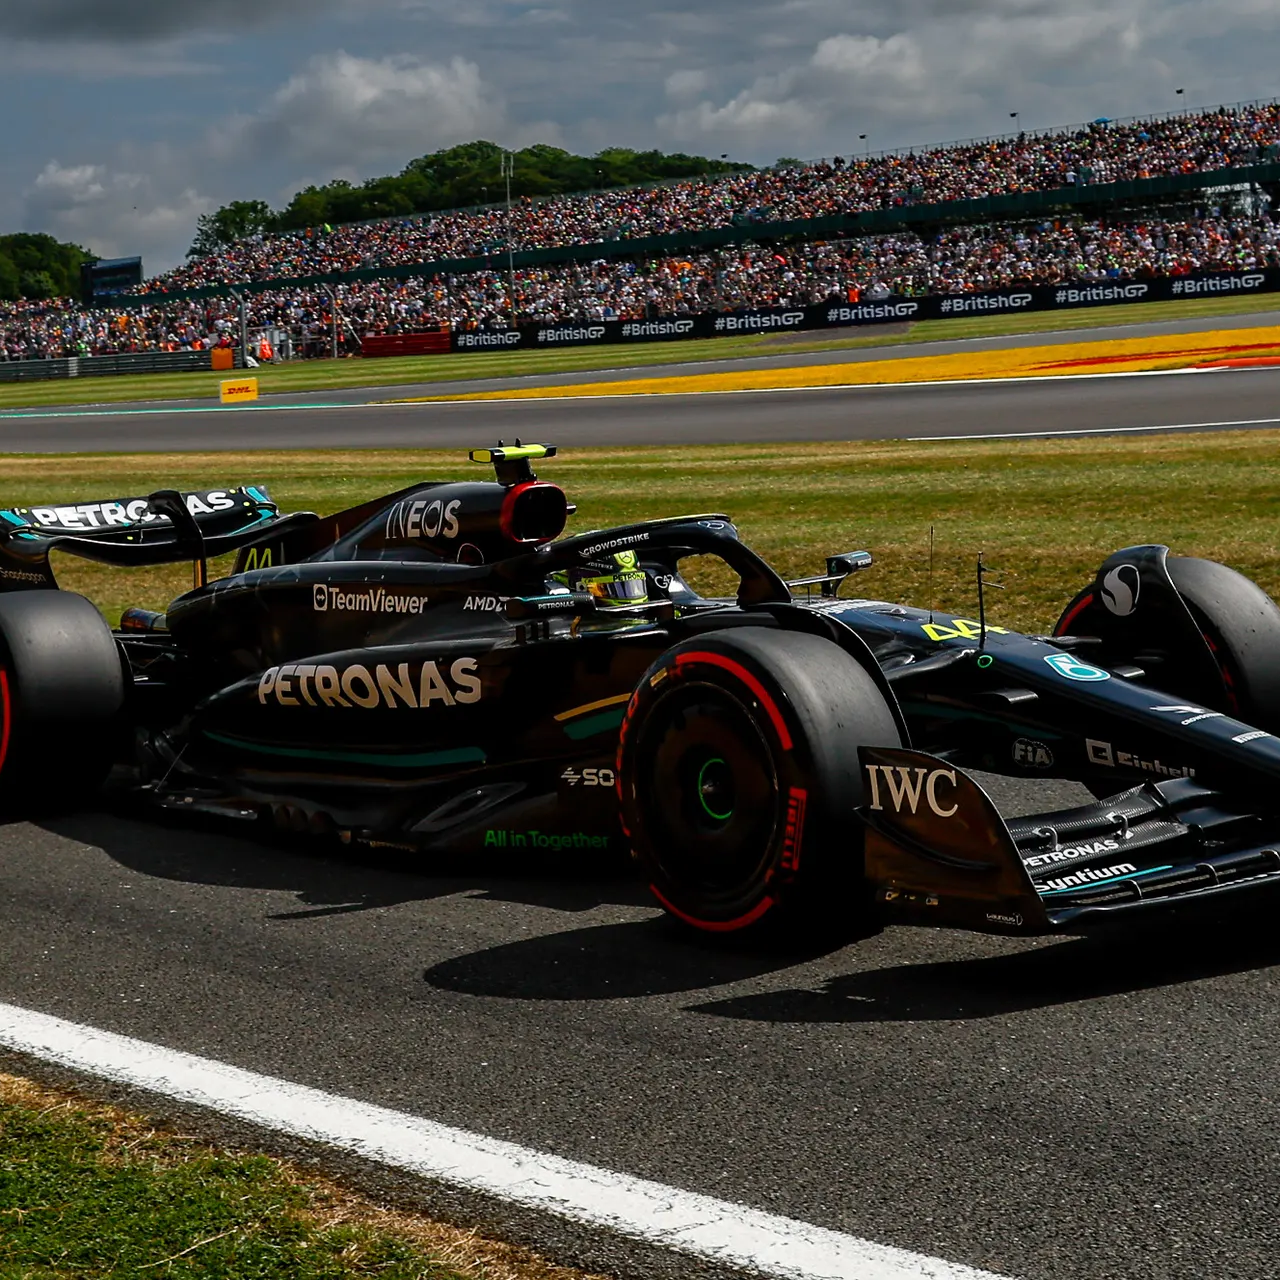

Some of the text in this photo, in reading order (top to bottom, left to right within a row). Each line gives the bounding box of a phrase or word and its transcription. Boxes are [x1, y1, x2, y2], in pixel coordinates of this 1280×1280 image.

[1055, 284, 1148, 303] #BritishGP
[1171, 274, 1265, 294] #BritishGP
[827, 303, 918, 321] #BritishGP
[941, 293, 1032, 312] #BritishGP
[621, 320, 694, 337] #BritishGP
[714, 312, 804, 330] #BritishGP
[458, 332, 521, 347] #BritishGP
[537, 327, 605, 341] #BritishGP
[31, 491, 235, 528] PETROAS
[385, 499, 462, 540] INEOS
[582, 532, 650, 557] CROWDSTRIKE
[328, 586, 428, 614] TeamViewer
[462, 595, 496, 612] AMD
[537, 600, 576, 610] PETRONAS
[258, 657, 482, 709] PETRONAS
[1116, 750, 1196, 778] Einhell
[864, 764, 959, 818] IWC
[484, 829, 611, 852] All in Together
[1035, 862, 1138, 893] Syntium
